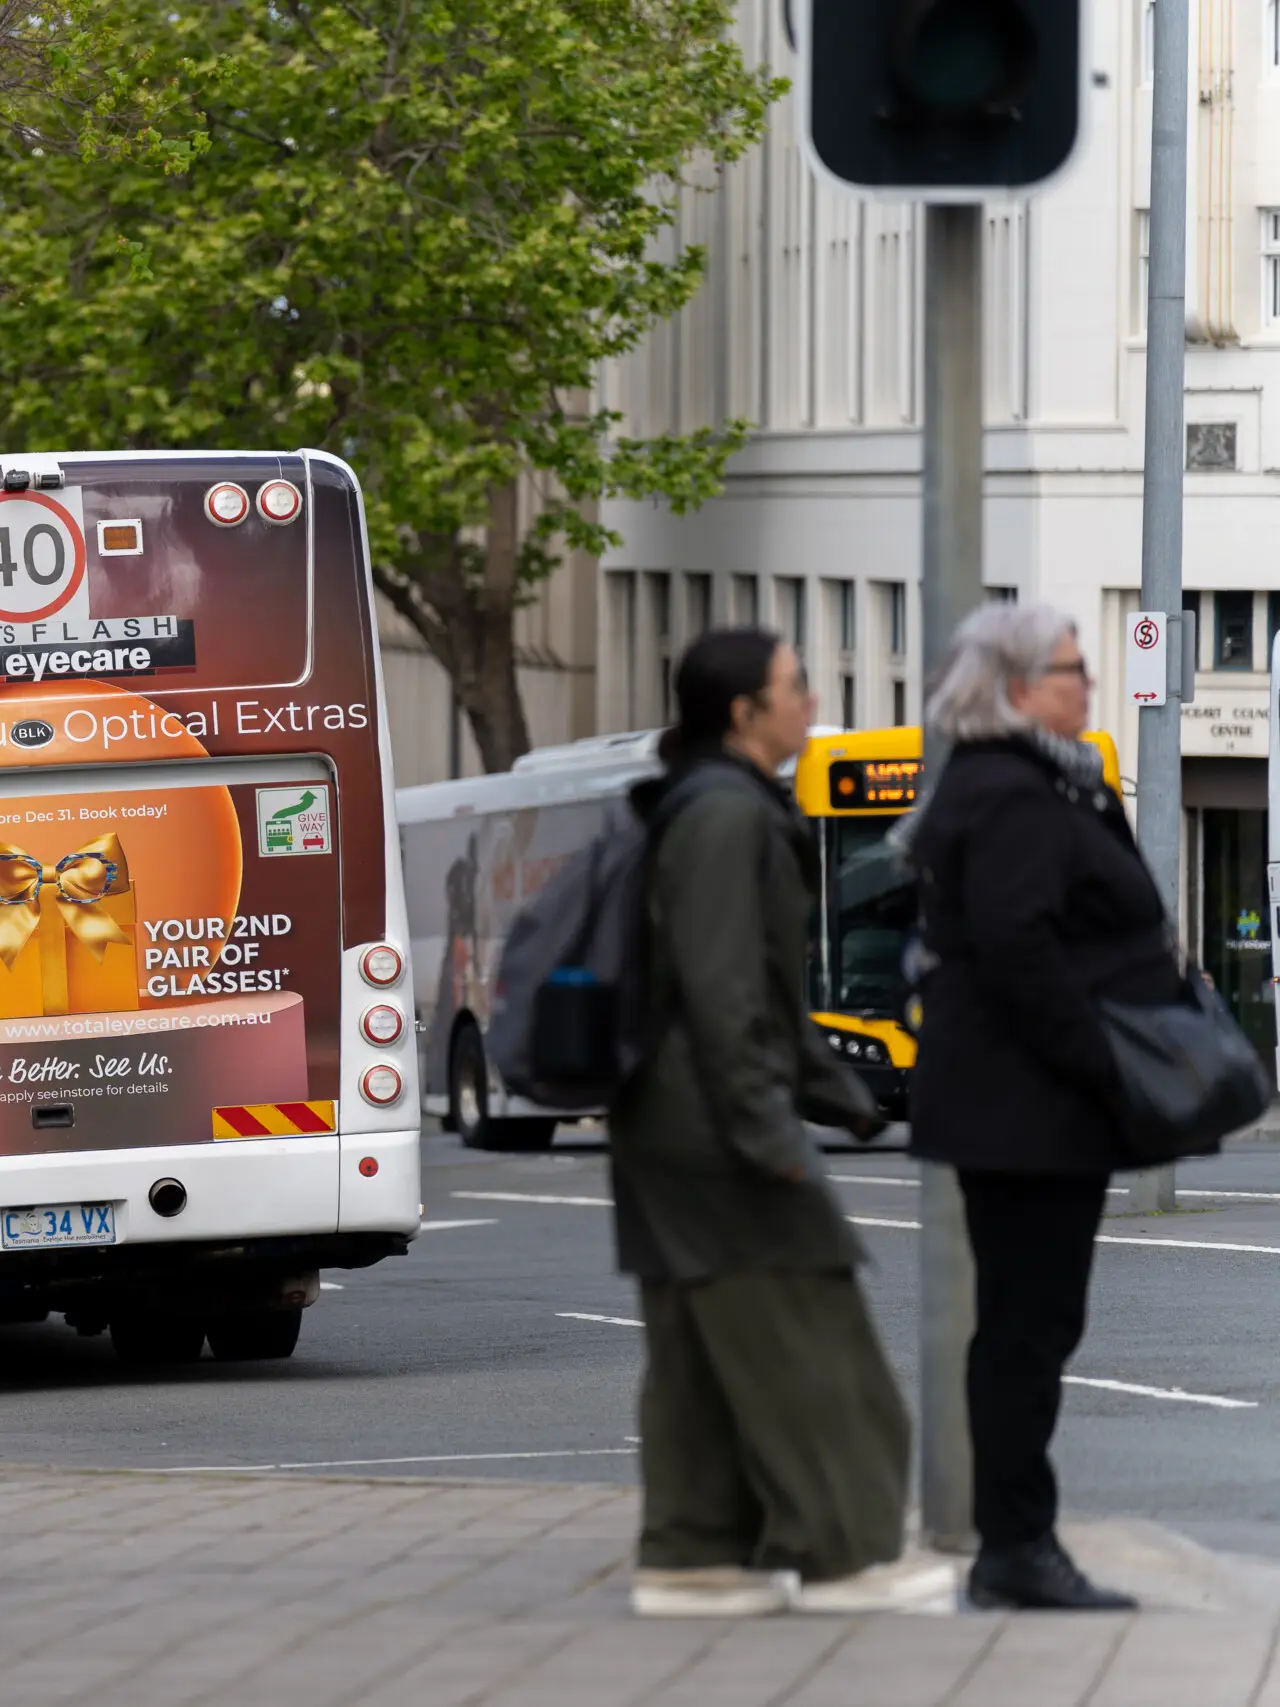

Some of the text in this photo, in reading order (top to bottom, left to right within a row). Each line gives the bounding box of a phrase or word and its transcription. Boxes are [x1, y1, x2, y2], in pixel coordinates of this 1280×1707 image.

[32, 616, 173, 643] FLASH
[5, 646, 152, 682] eyecare
[18, 727, 46, 739] BLK
[63, 701, 219, 749] Optical
[236, 700, 368, 735] Extras
[1210, 726, 1252, 737] CENTRE
[25, 810, 54, 823] Dec
[57, 809, 75, 821] 31.
[79, 806, 117, 820] Book
[120, 804, 167, 819] today!
[297, 812, 326, 823] GIVE
[299, 821, 325, 832] WAY
[143, 914, 292, 942] YOUR 2ND
[145, 943, 260, 970] PAIR OF
[5, 1010, 272, 1038] www.totaleyecare.com.au
[8, 1057, 80, 1084] Better.
[88, 1054, 132, 1078] See
[138, 1052, 173, 1076] Us.
[0, 1089, 34, 1103] apply
[106, 1084, 124, 1095] for
[126, 1082, 169, 1094] details
[5, 1207, 110, 1239] C 34 VX
[12, 1237, 39, 1245] Tasmania
